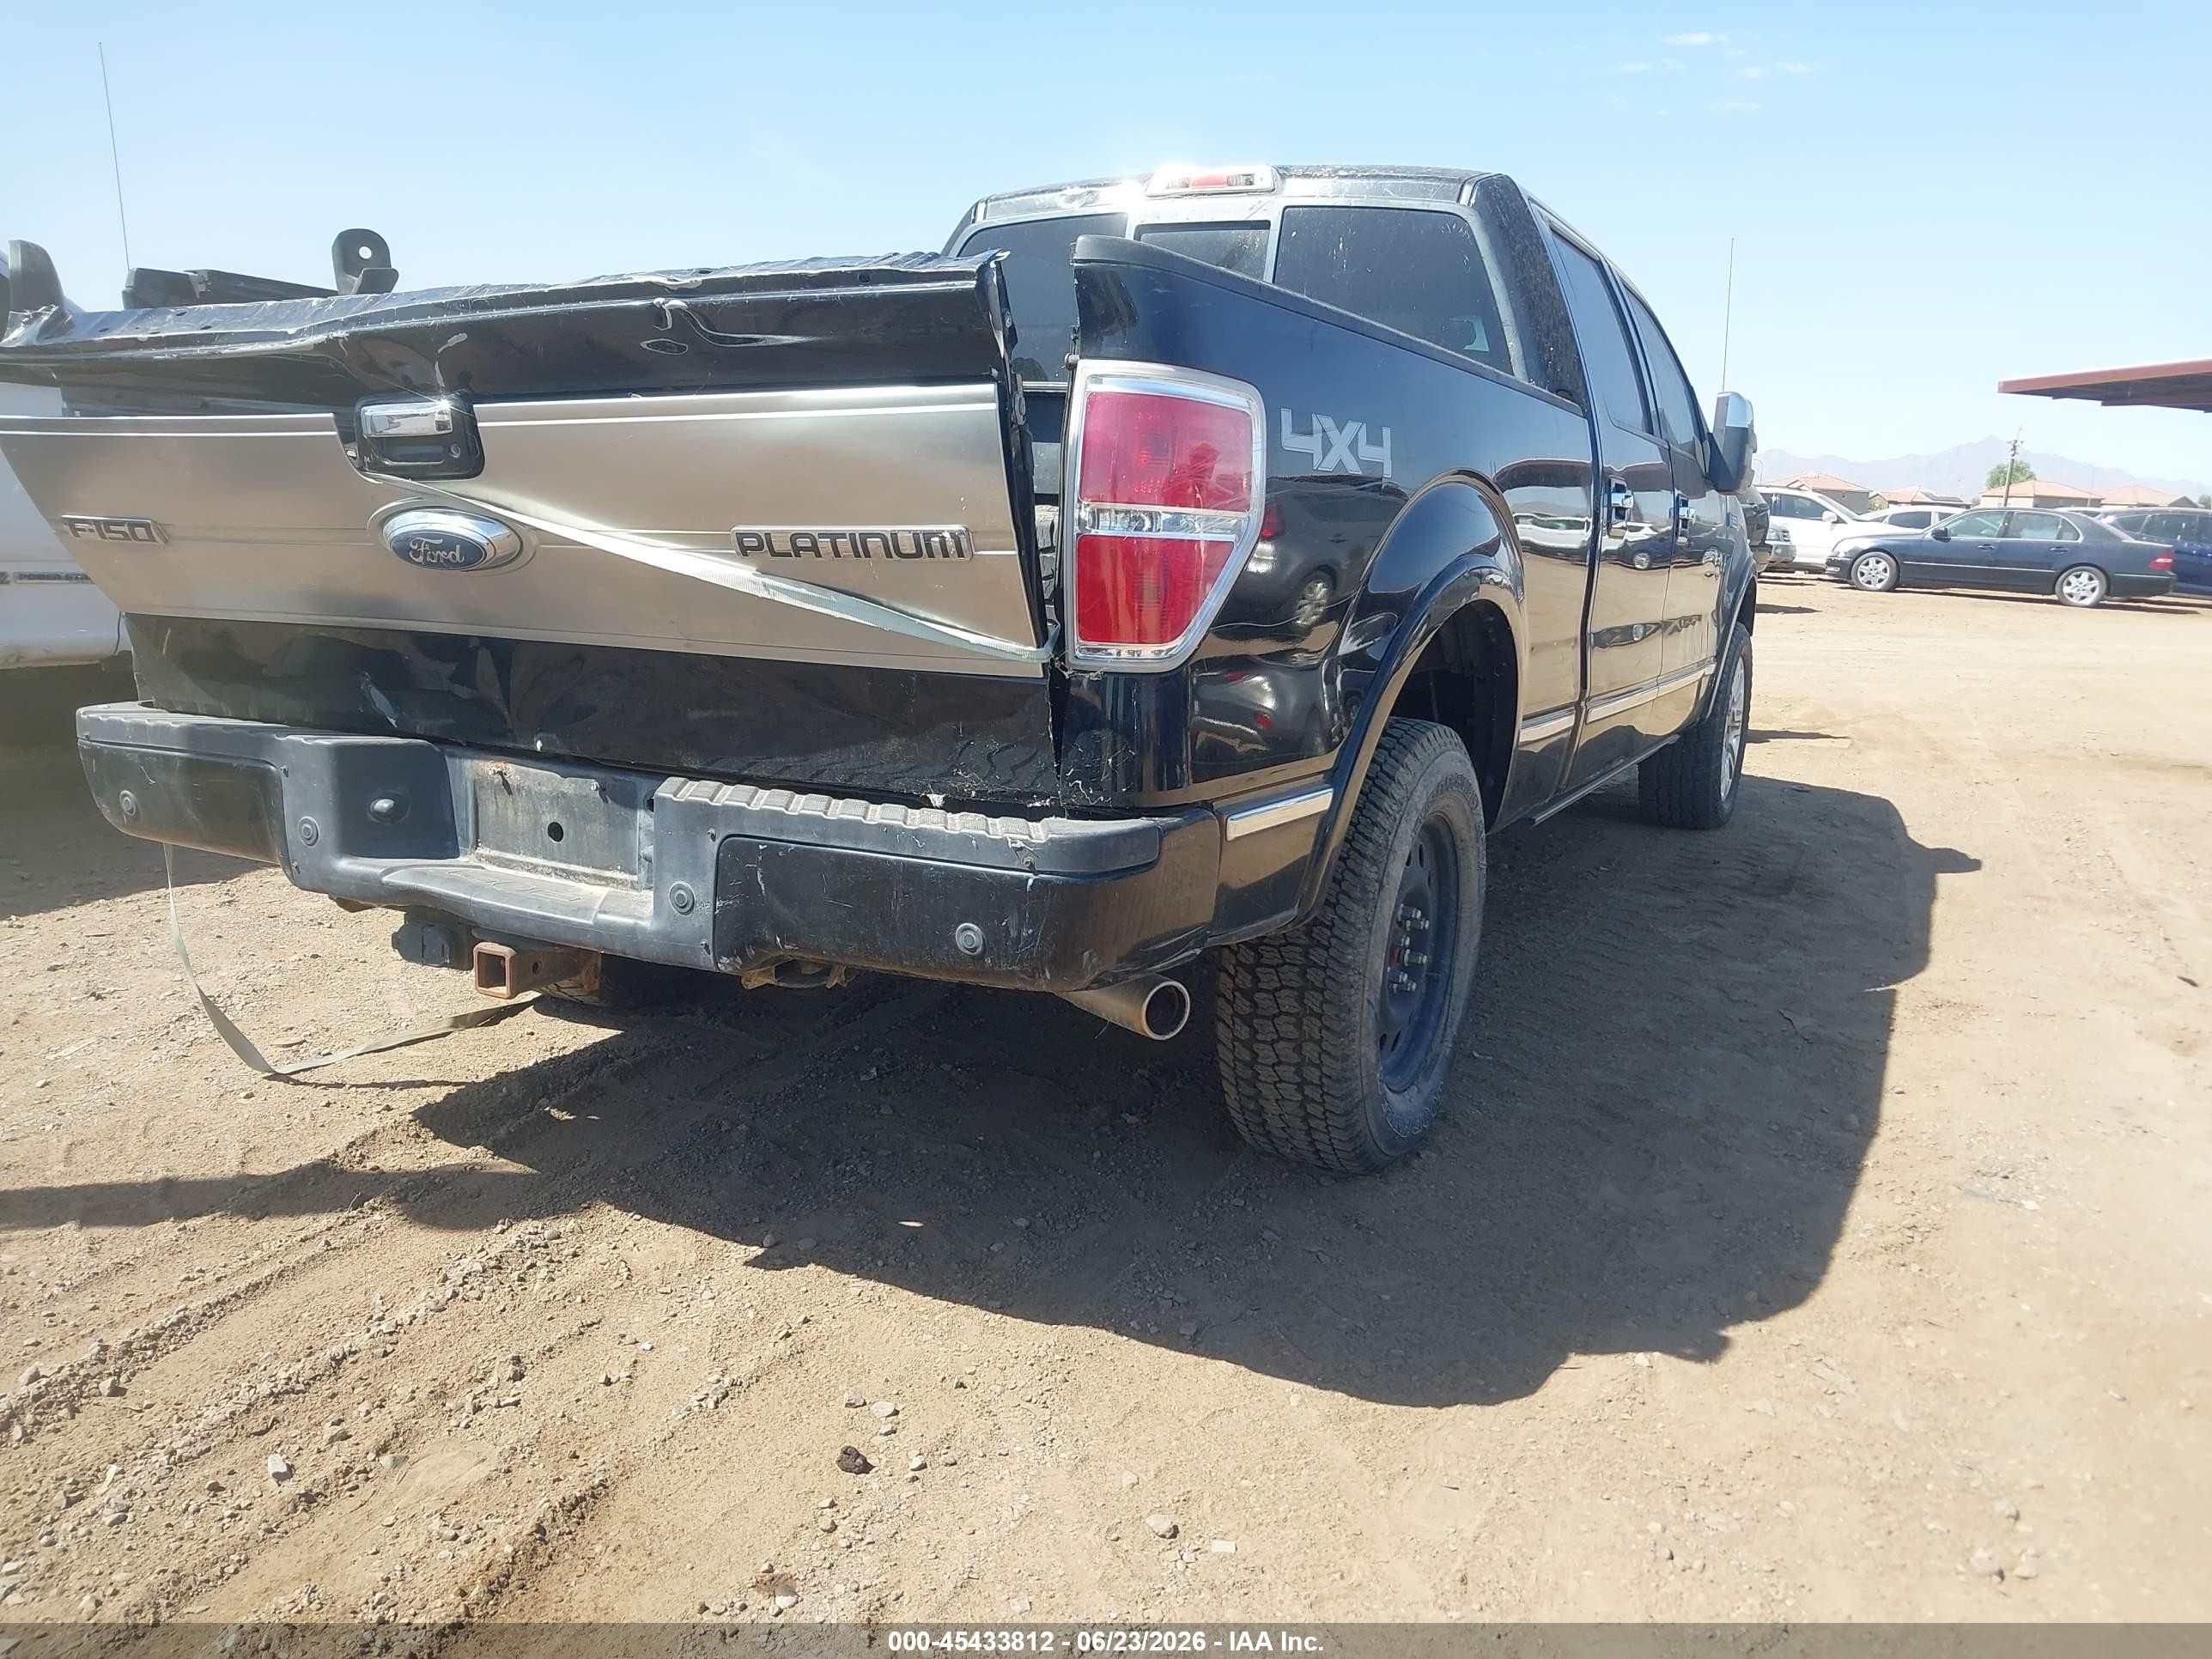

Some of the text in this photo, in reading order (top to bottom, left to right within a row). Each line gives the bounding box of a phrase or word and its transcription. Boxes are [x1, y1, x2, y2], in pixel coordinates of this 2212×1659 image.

[1279, 407, 1393, 479] 4X4
[67, 520, 158, 544] F-150
[735, 531, 966, 559] PLATINUM
[409, 537, 465, 567] Ford
